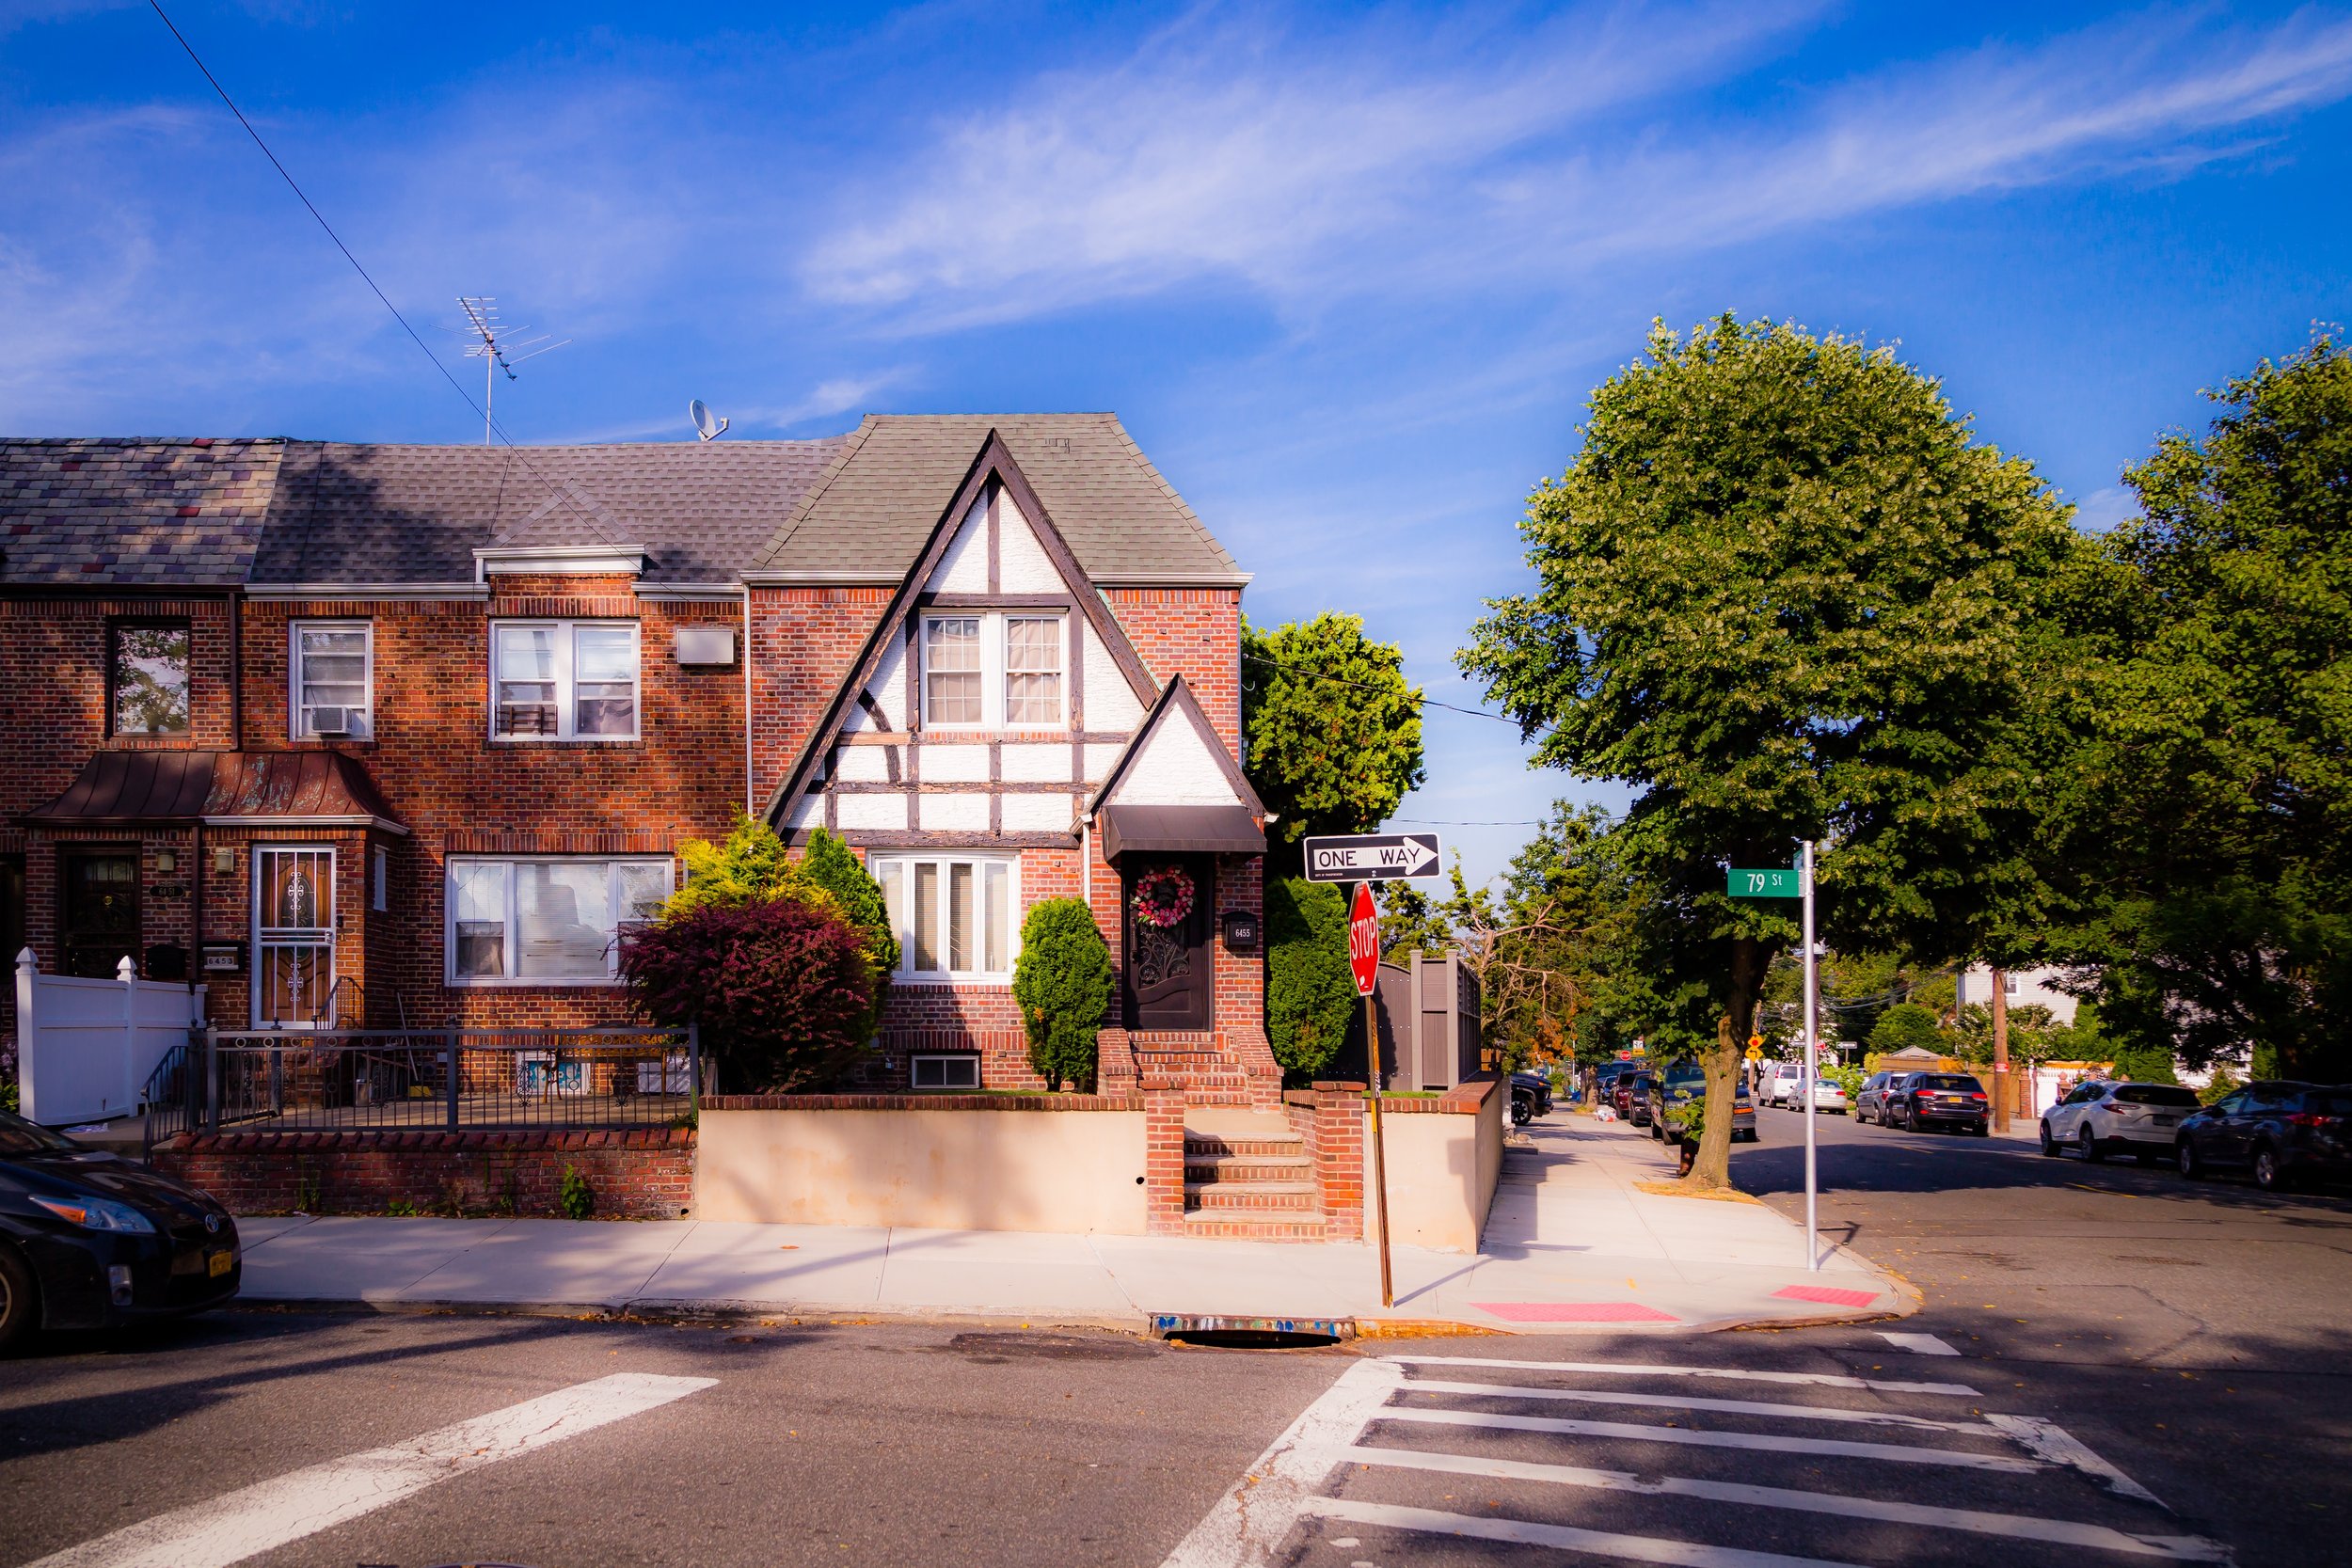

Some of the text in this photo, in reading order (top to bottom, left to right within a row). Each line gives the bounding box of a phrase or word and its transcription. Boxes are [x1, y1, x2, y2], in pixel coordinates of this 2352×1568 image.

[1319, 847, 1421, 867] ONE WAY
[1746, 873, 1783, 893] 79 St
[1235, 928, 1250, 938] 6455
[1351, 916, 1375, 960] STOP
